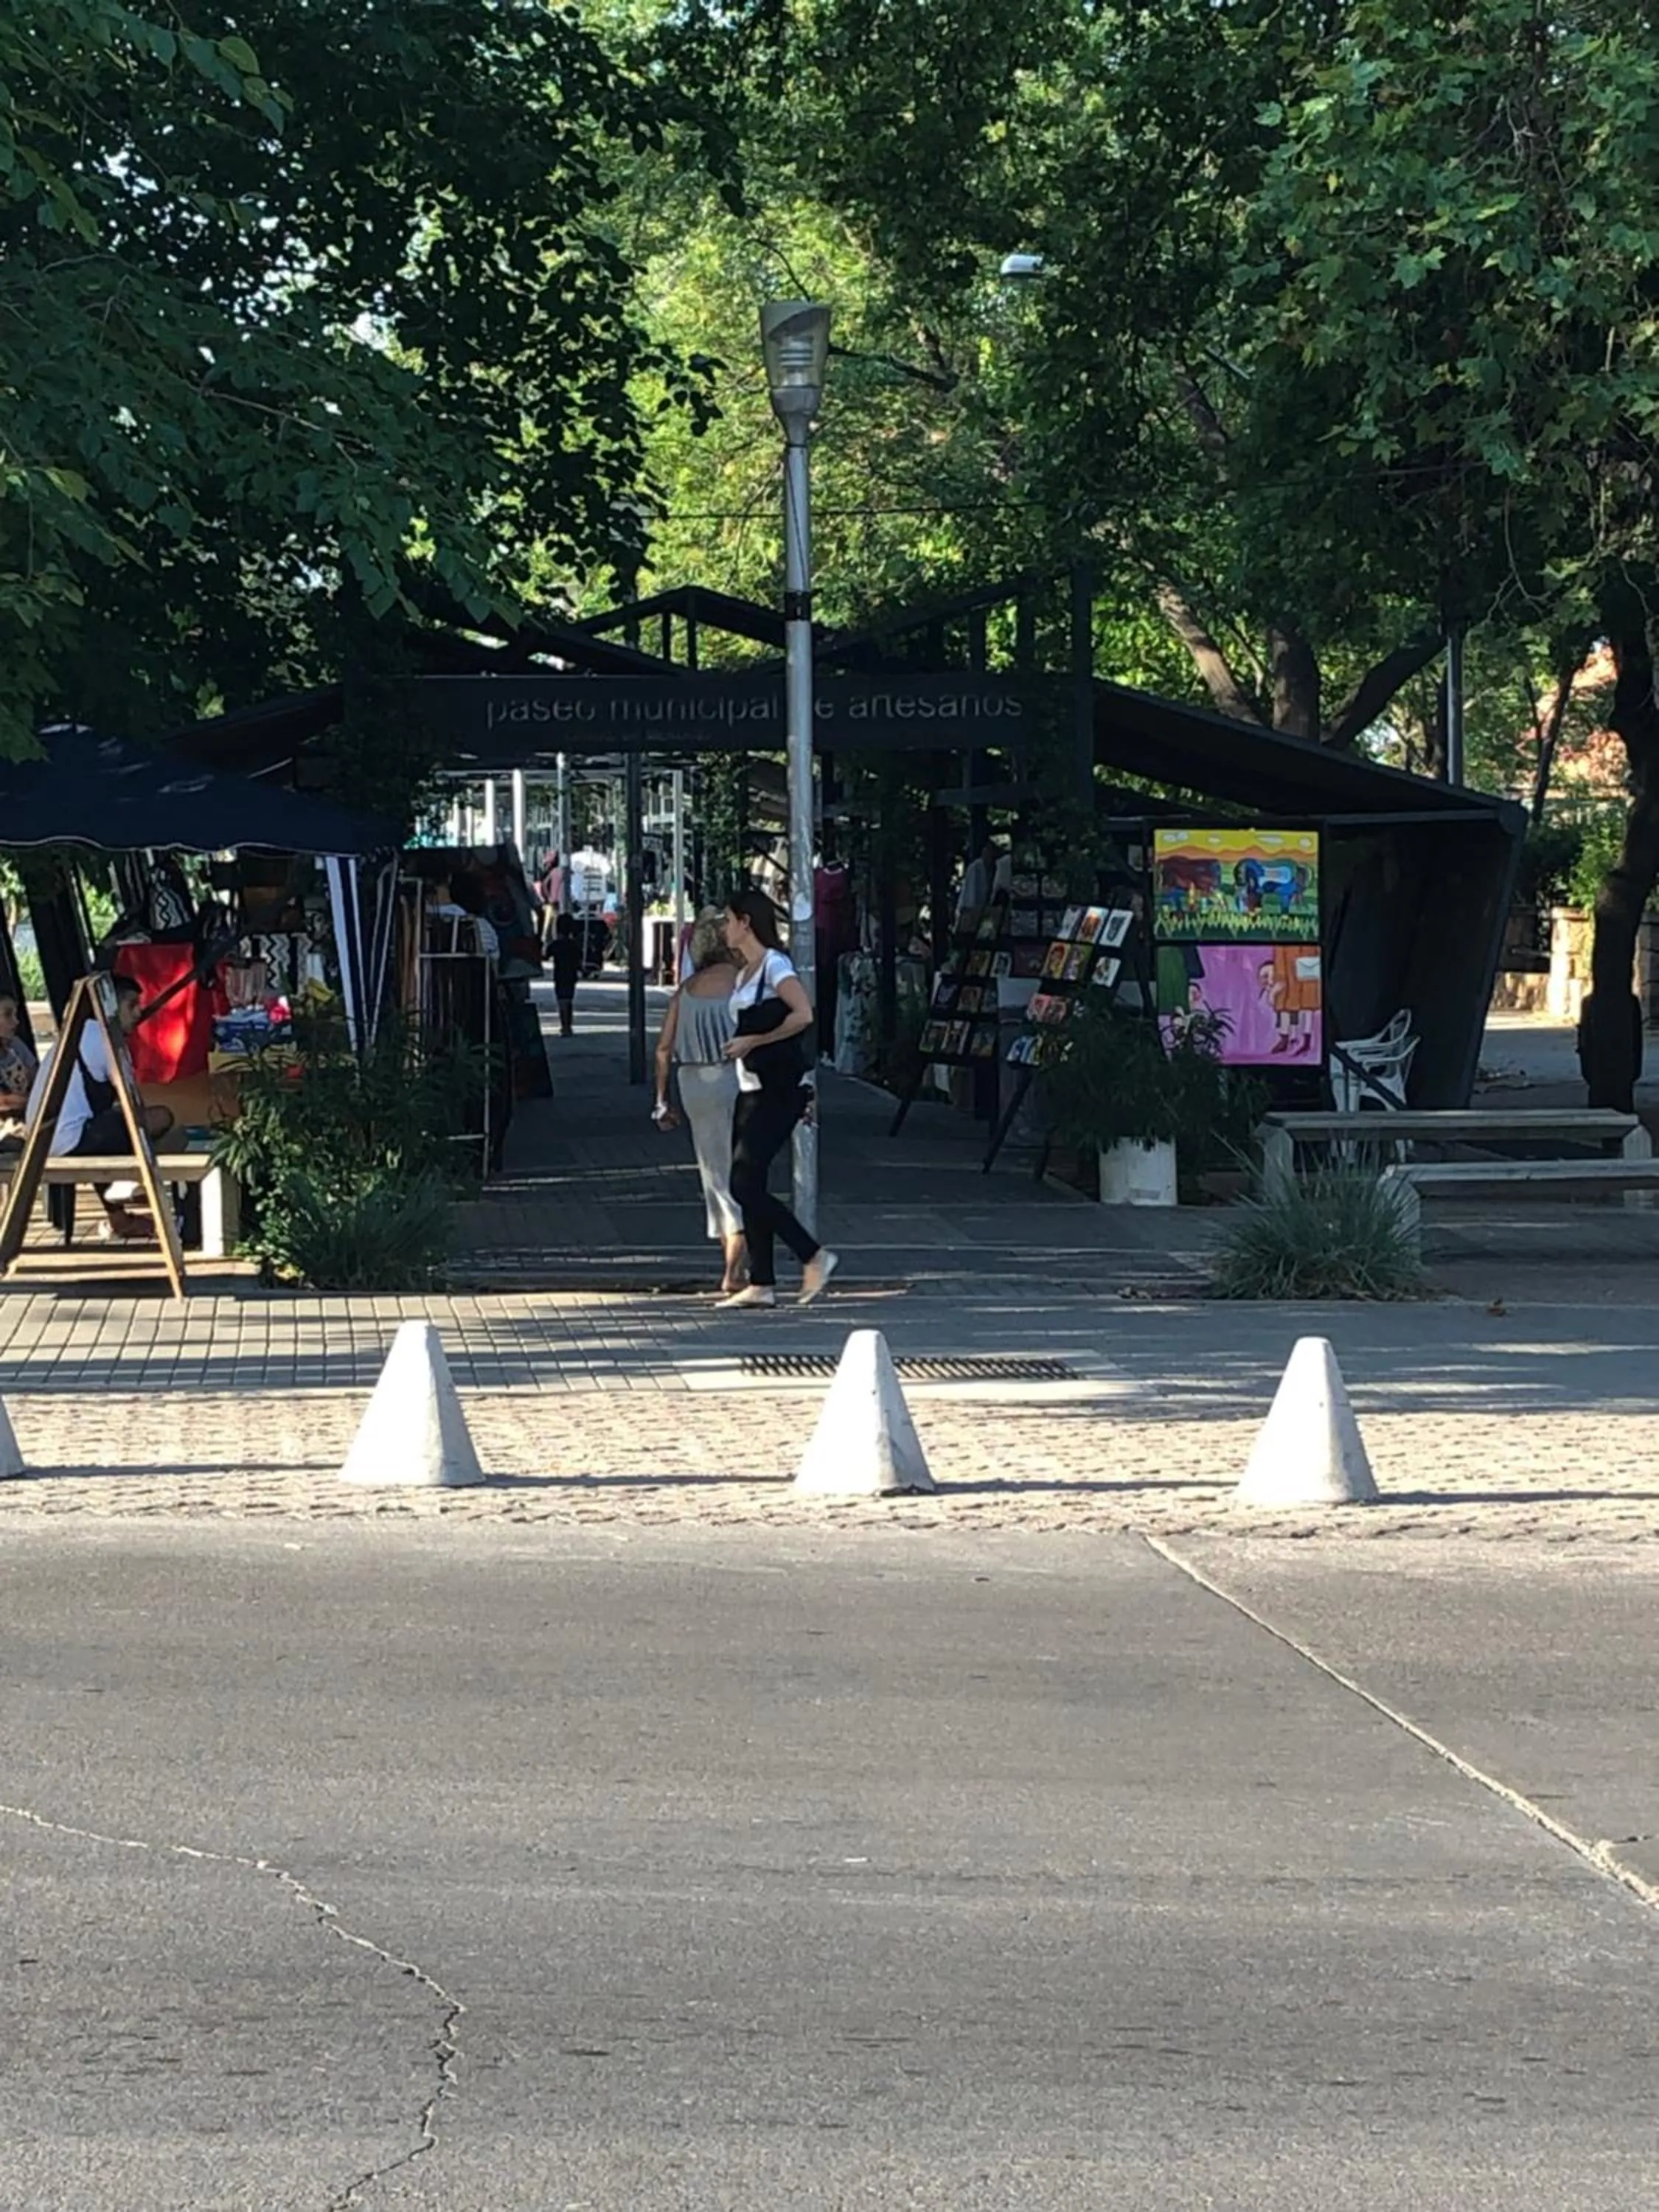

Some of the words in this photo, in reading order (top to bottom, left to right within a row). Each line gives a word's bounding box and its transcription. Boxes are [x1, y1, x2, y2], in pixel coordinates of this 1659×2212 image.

[487, 695, 597, 730] paseo
[610, 692, 779, 726] municipal
[848, 693, 1023, 720] artesanos
